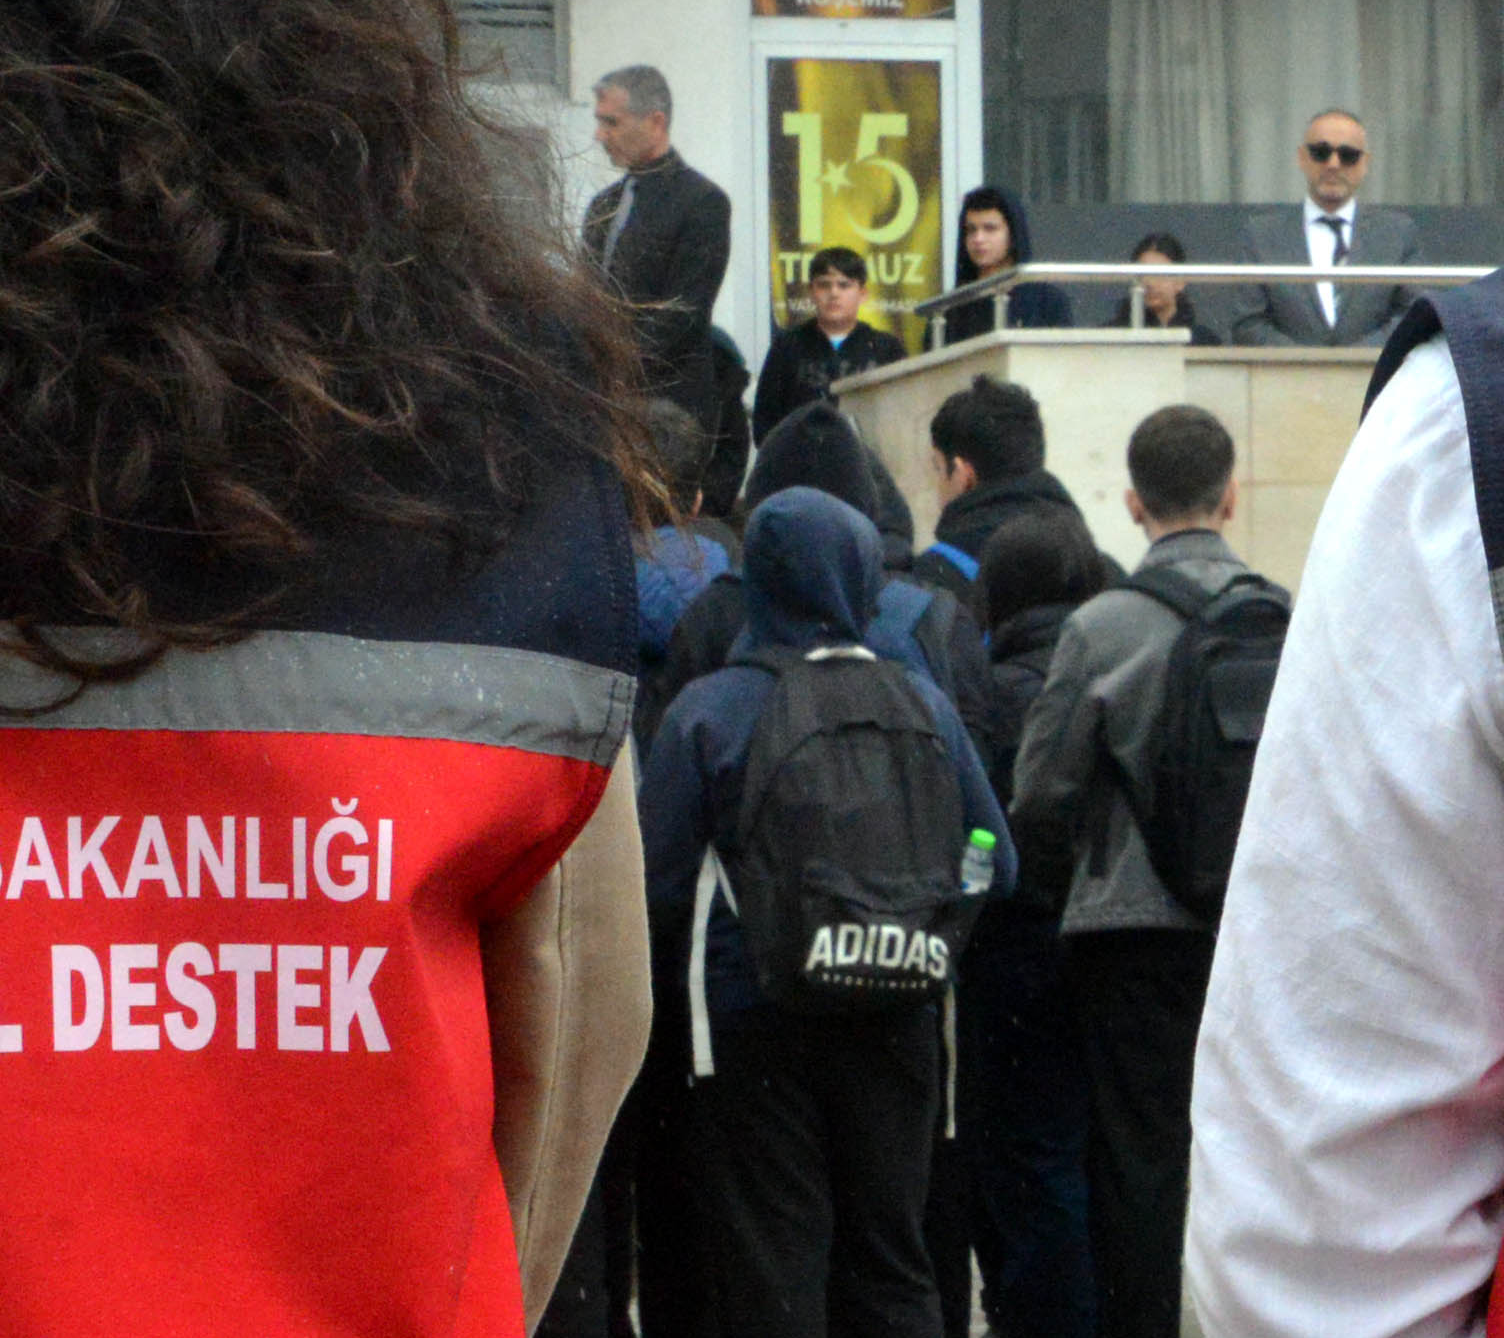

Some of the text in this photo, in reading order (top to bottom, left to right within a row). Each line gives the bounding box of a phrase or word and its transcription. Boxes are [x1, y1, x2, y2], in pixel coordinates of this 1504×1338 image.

[782, 111, 920, 245] 15
[51, 940, 391, 1052] DESTEK
[804, 922, 950, 980] ADIDAS
